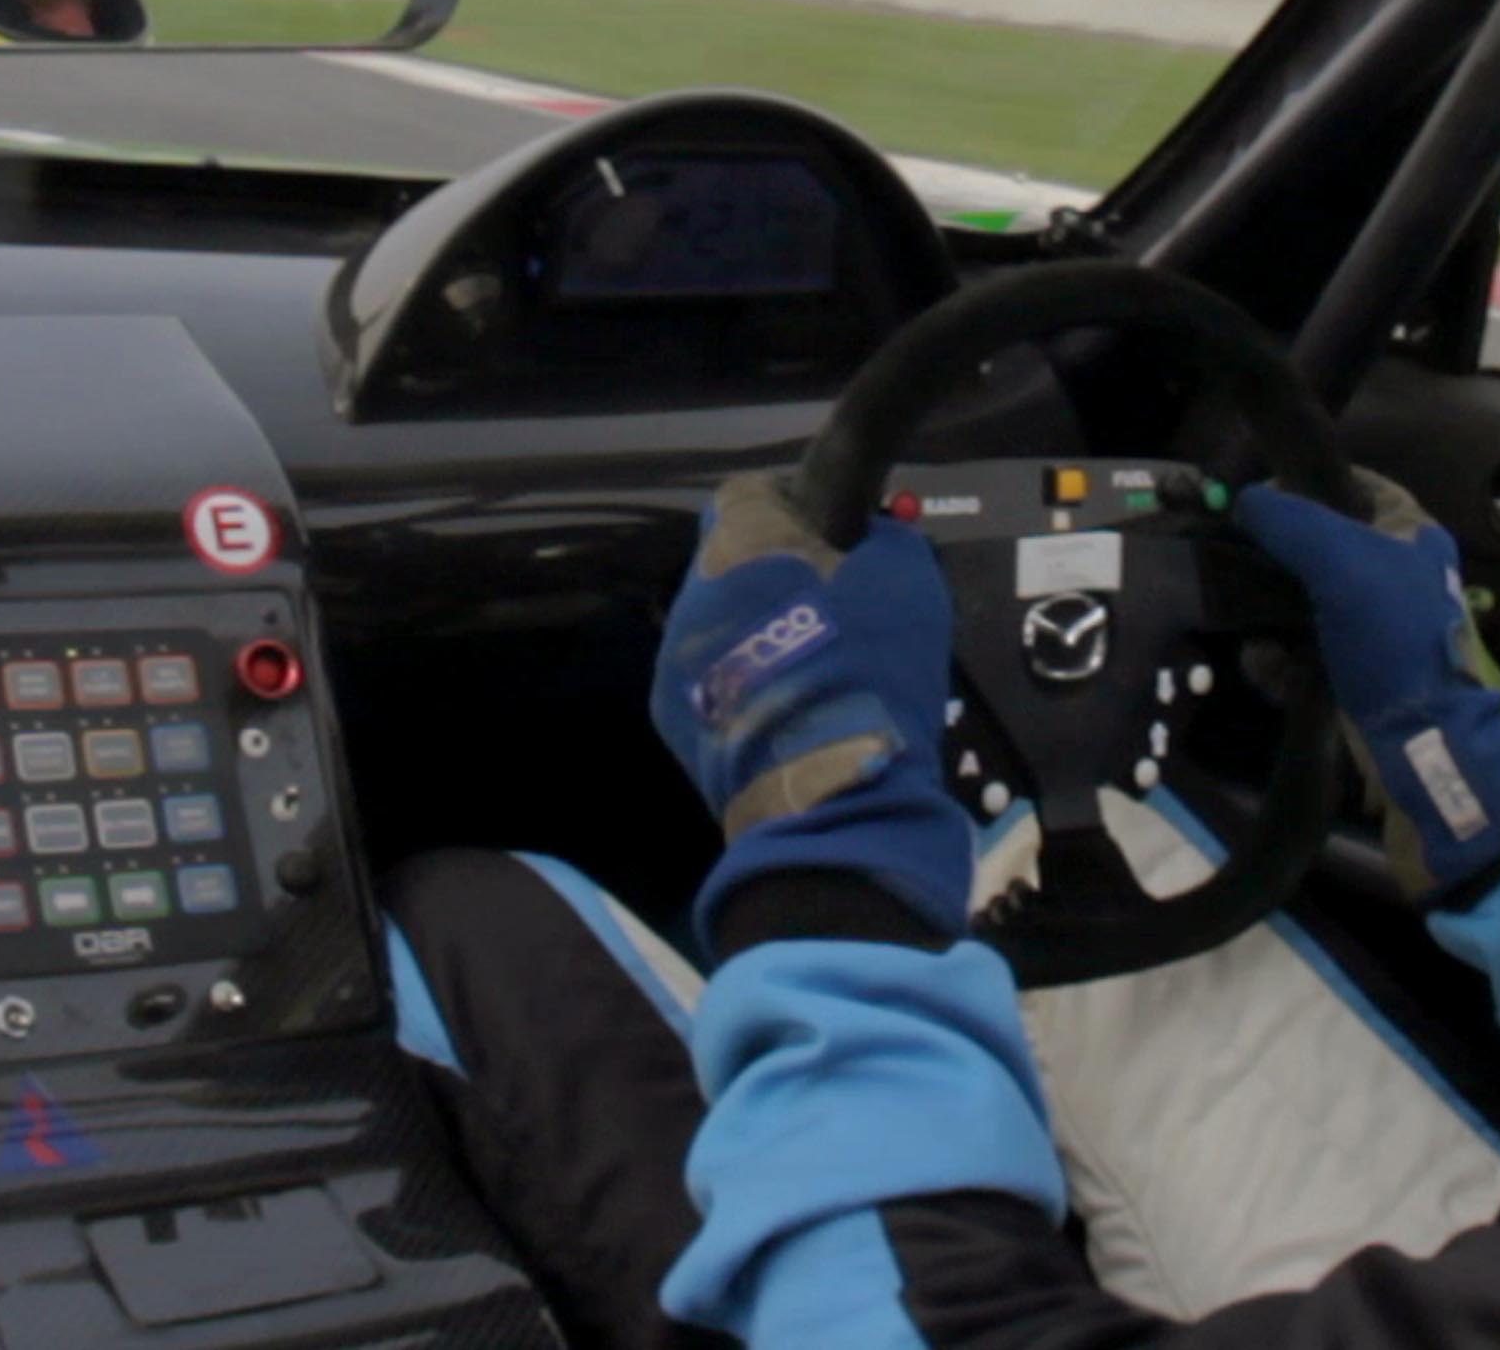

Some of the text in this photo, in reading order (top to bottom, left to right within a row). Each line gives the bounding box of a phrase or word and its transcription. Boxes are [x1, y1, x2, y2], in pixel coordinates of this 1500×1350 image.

[1111, 469, 1155, 489] FUEL
[921, 495, 982, 516] RADIO
[209, 504, 255, 551] E
